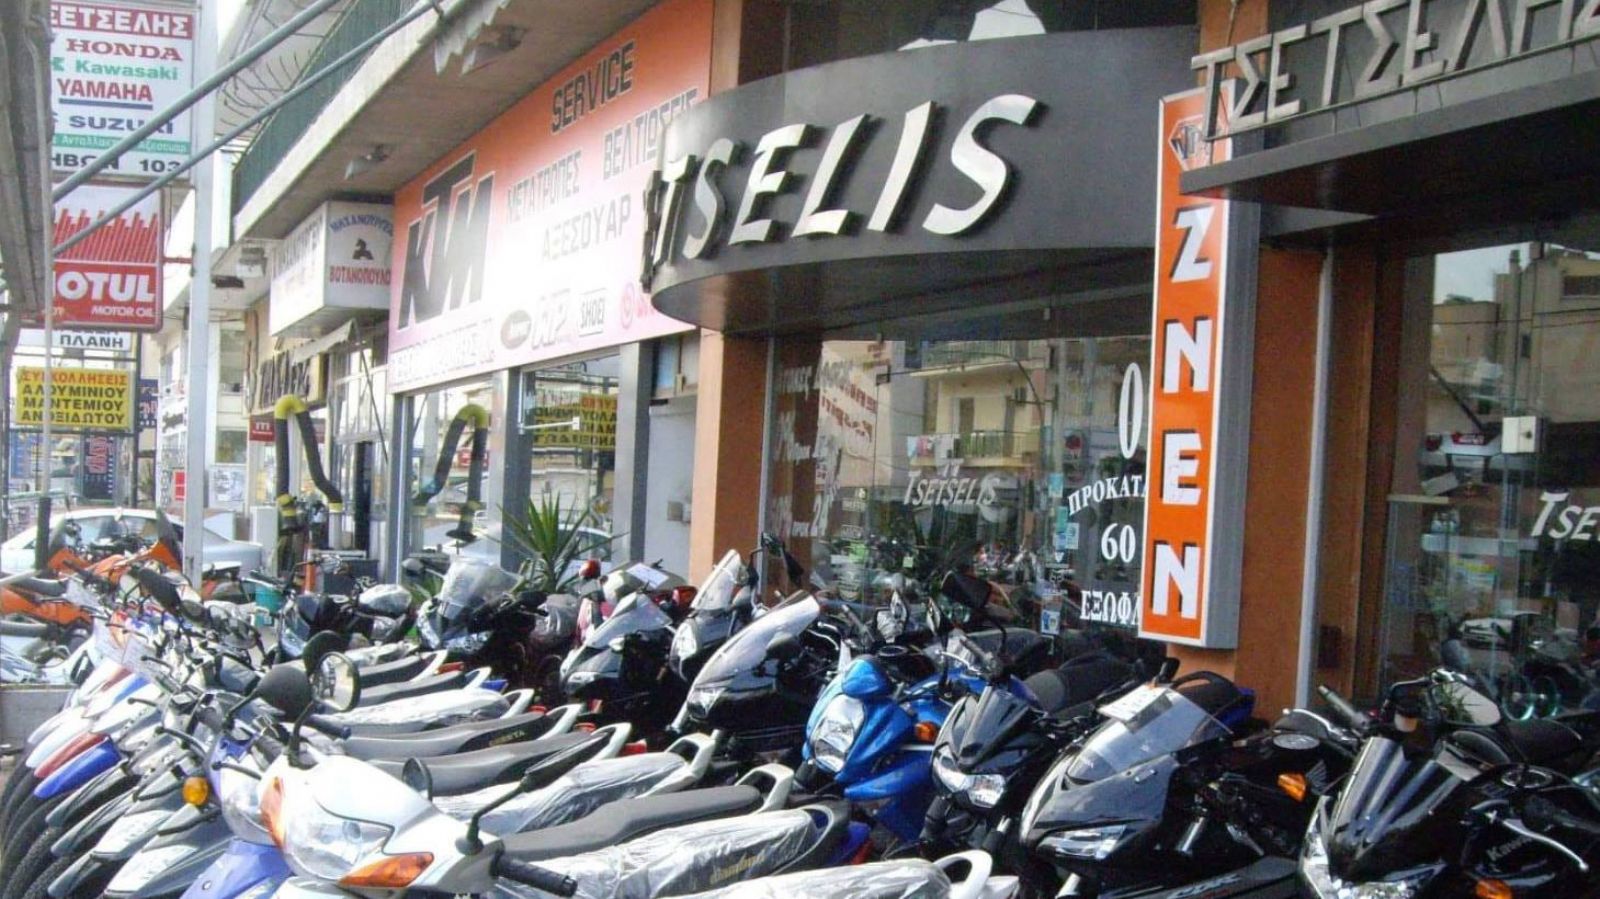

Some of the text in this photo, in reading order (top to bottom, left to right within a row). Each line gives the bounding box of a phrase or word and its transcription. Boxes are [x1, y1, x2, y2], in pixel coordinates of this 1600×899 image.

[66, 39, 183, 61] HONDA
[75, 59, 179, 80] Kawasaki
[57, 78, 153, 102] YAMAHA
[552, 39, 636, 133] SERVICE
[69, 115, 174, 135] SUZUI
[397, 149, 495, 332] KTM
[52, 271, 155, 303] OTUL
[91, 306, 134, 317] MOTOR
[60, 334, 124, 348] ΠΛΑΝΗ
[1150, 206, 1215, 621] ZNEN
[904, 468, 1001, 507] TSETSELIS
[1101, 522, 1137, 563] 60
